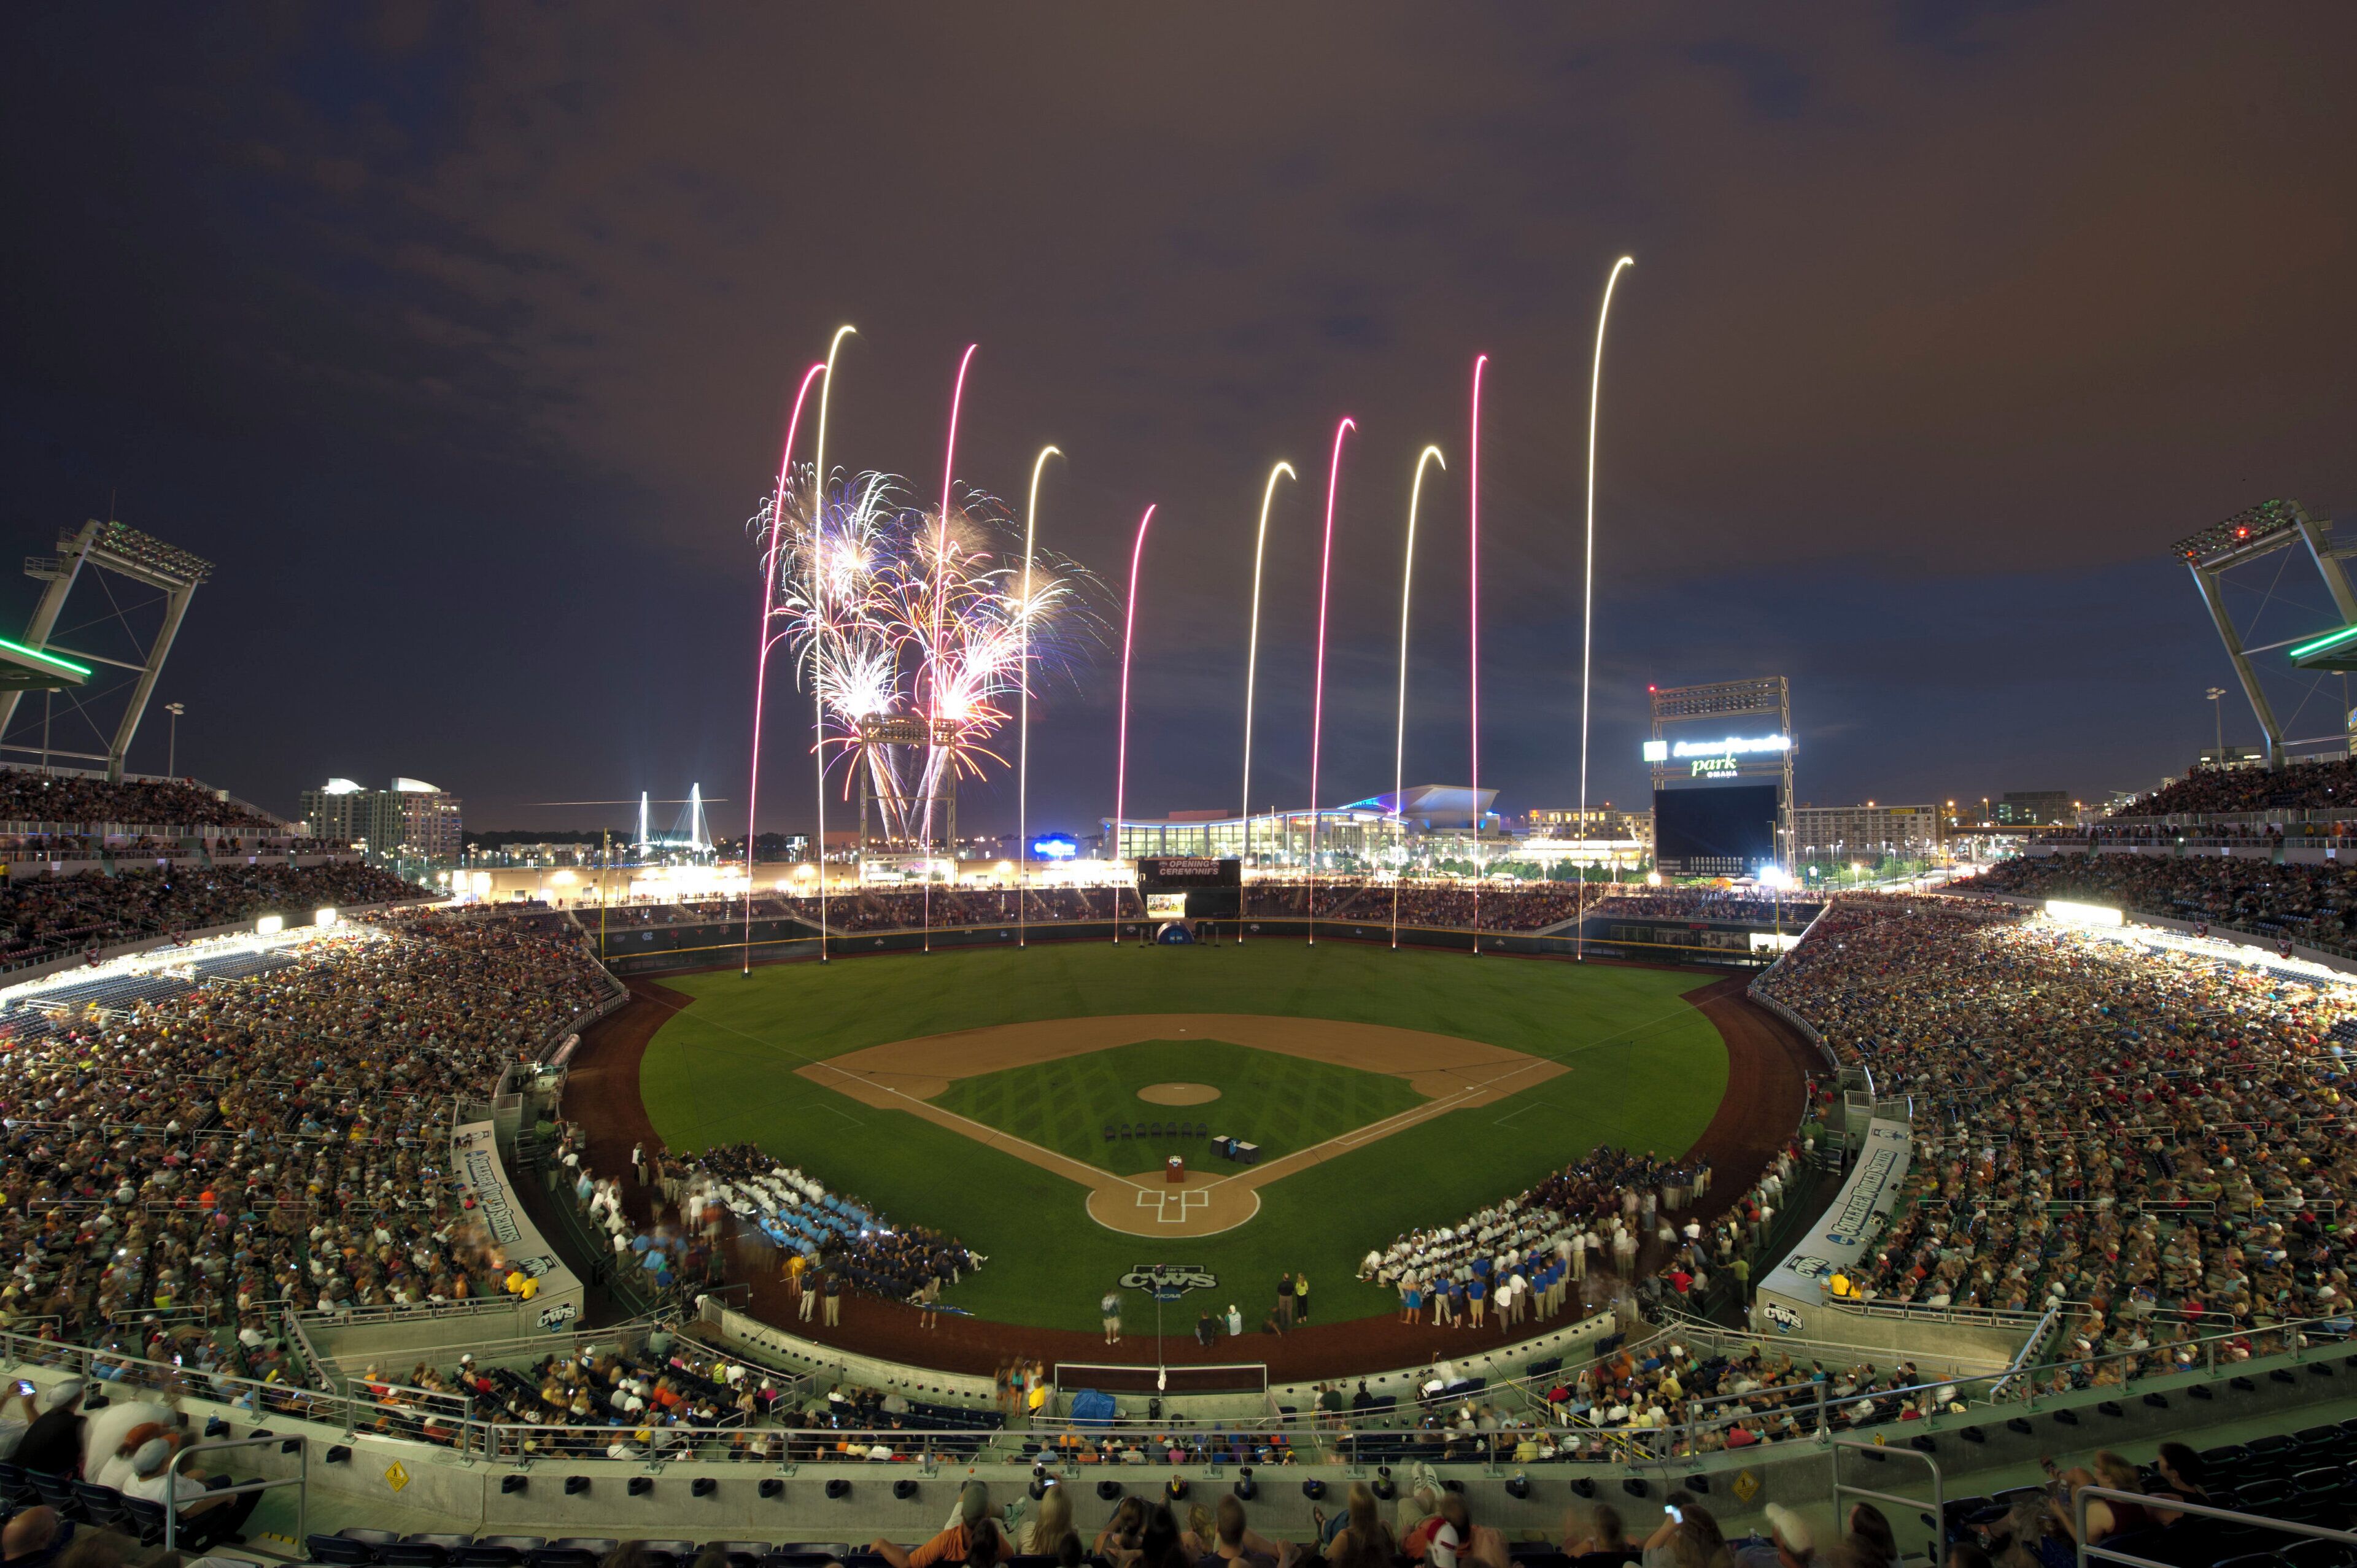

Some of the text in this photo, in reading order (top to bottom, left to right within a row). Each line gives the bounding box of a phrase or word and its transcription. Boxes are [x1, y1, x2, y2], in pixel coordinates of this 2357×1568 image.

[1691, 750, 1736, 777] park
[466, 1156, 497, 1188] COLLEGE
[489, 1209, 522, 1244] SERIES
[1831, 1149, 1898, 1236] COLLEGE WORLD SERIES
[517, 1256, 548, 1278] CWS
[1795, 1256, 1829, 1278] CWS
[1120, 1273, 1217, 1288] CWS
[536, 1307, 576, 1328] CWS
[1763, 1307, 1803, 1329] CWS
